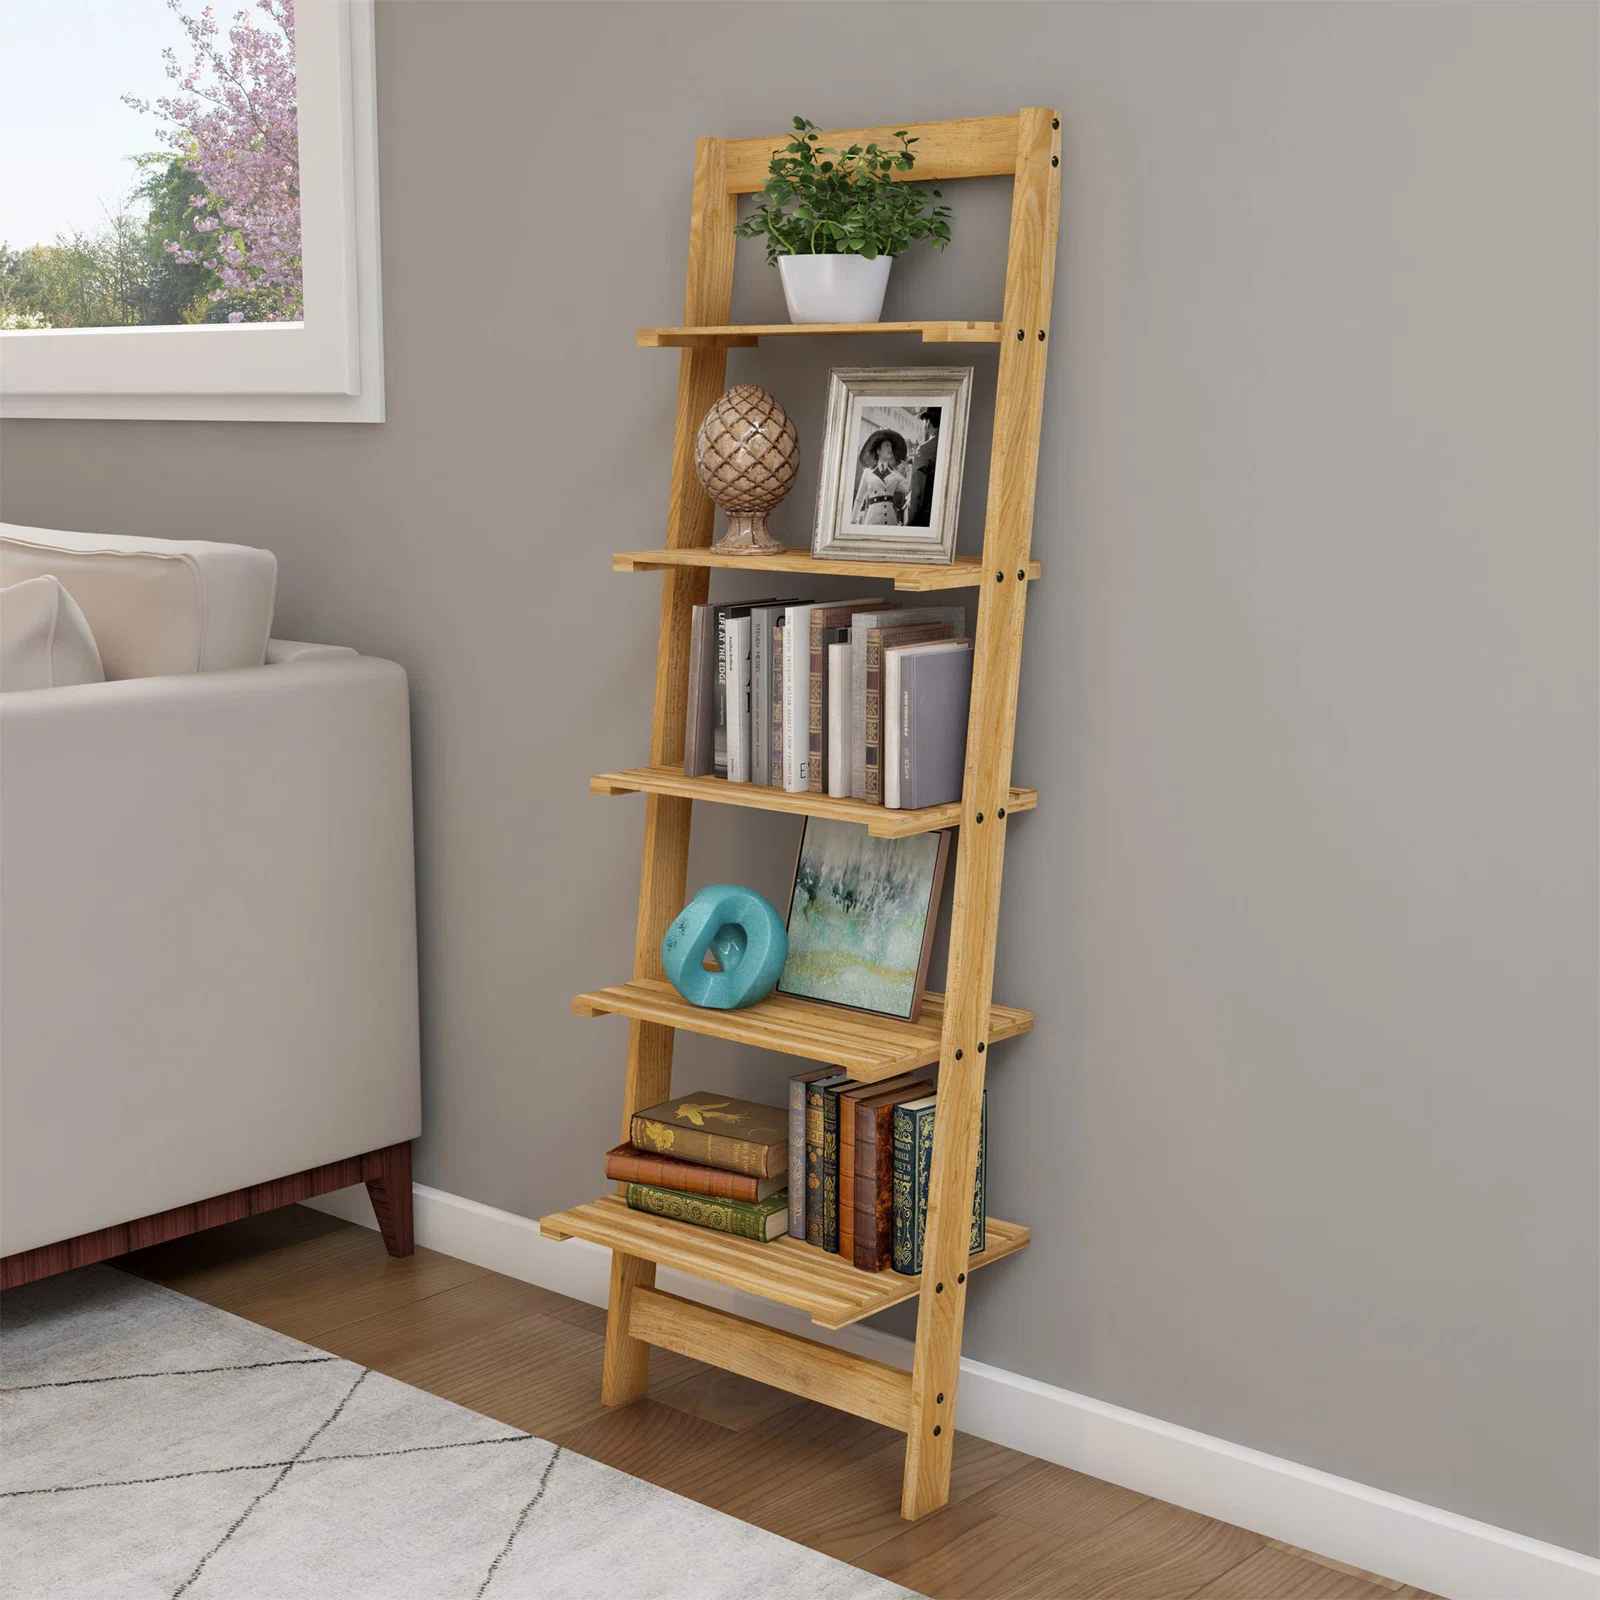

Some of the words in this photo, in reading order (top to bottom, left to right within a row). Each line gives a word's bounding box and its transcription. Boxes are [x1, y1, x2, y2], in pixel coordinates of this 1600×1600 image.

[718, 631, 726, 643] AT
[718, 643, 726, 661] THE
[718, 662, 726, 685] EDGE
